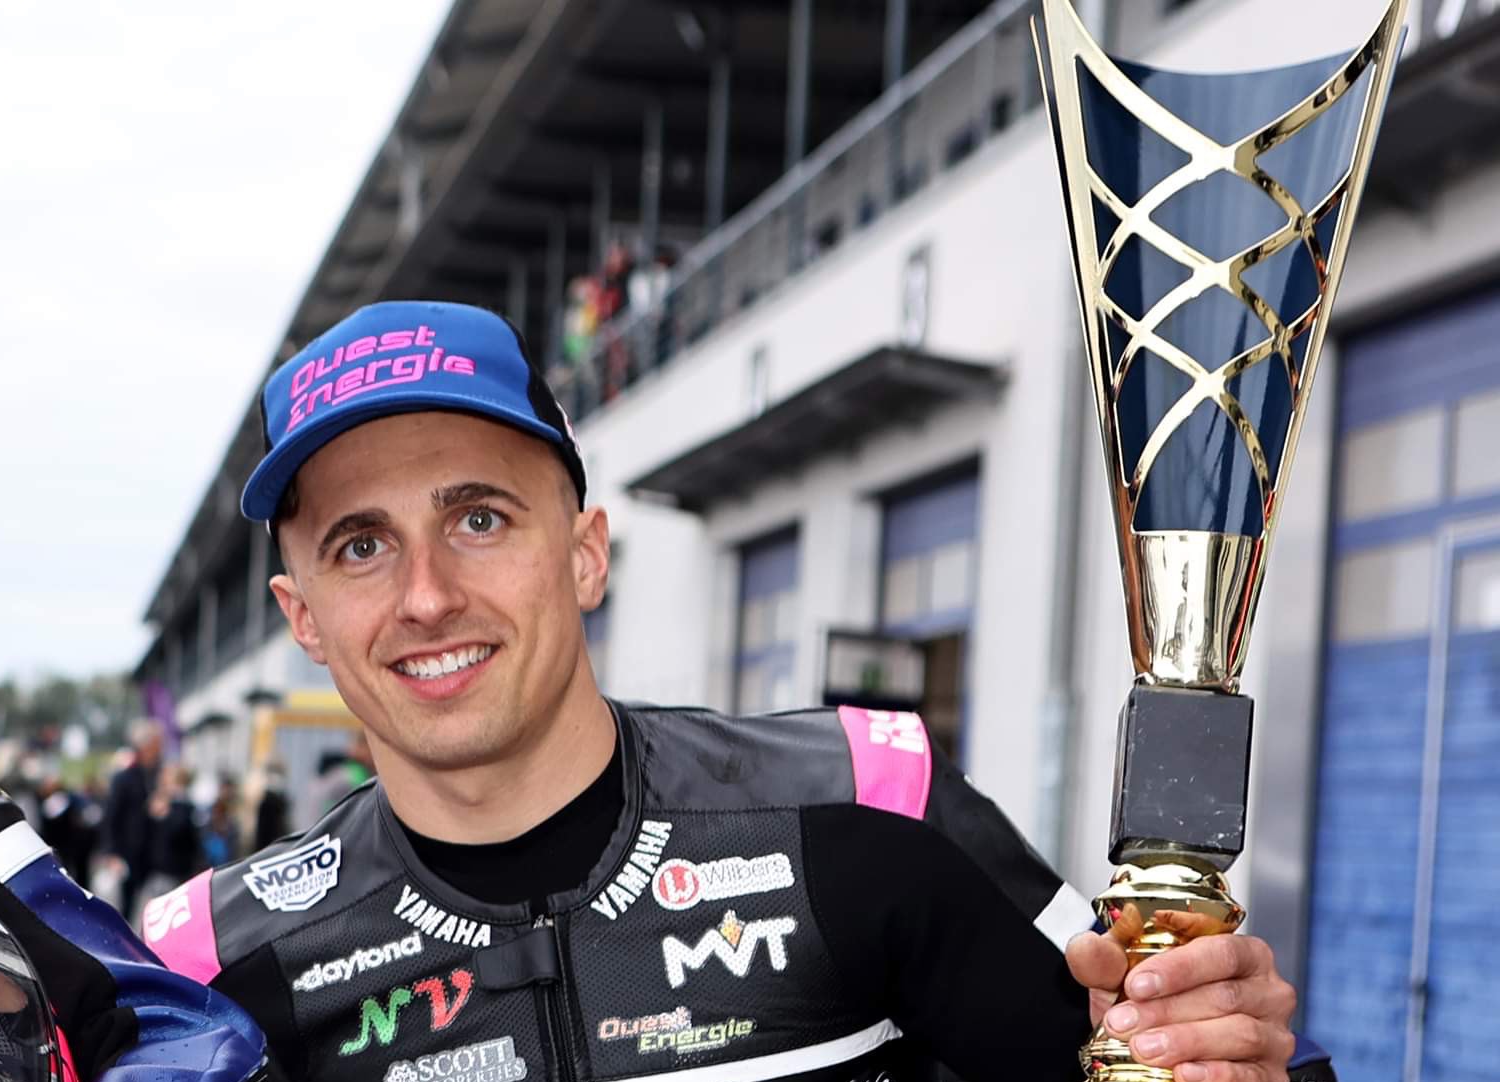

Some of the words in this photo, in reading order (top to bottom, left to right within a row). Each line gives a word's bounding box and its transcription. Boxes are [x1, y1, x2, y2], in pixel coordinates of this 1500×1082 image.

[286, 347, 475, 433] Energie
[254, 847, 337, 893] MOTO
[590, 820, 673, 920] YAMAHA
[702, 857, 787, 886] Wilbers
[393, 884, 491, 948] YAMAHA
[300, 930, 423, 992] daytona
[662, 917, 797, 989] MVT
[417, 1040, 509, 1082] SCOTT
[638, 1018, 757, 1054] Energie
